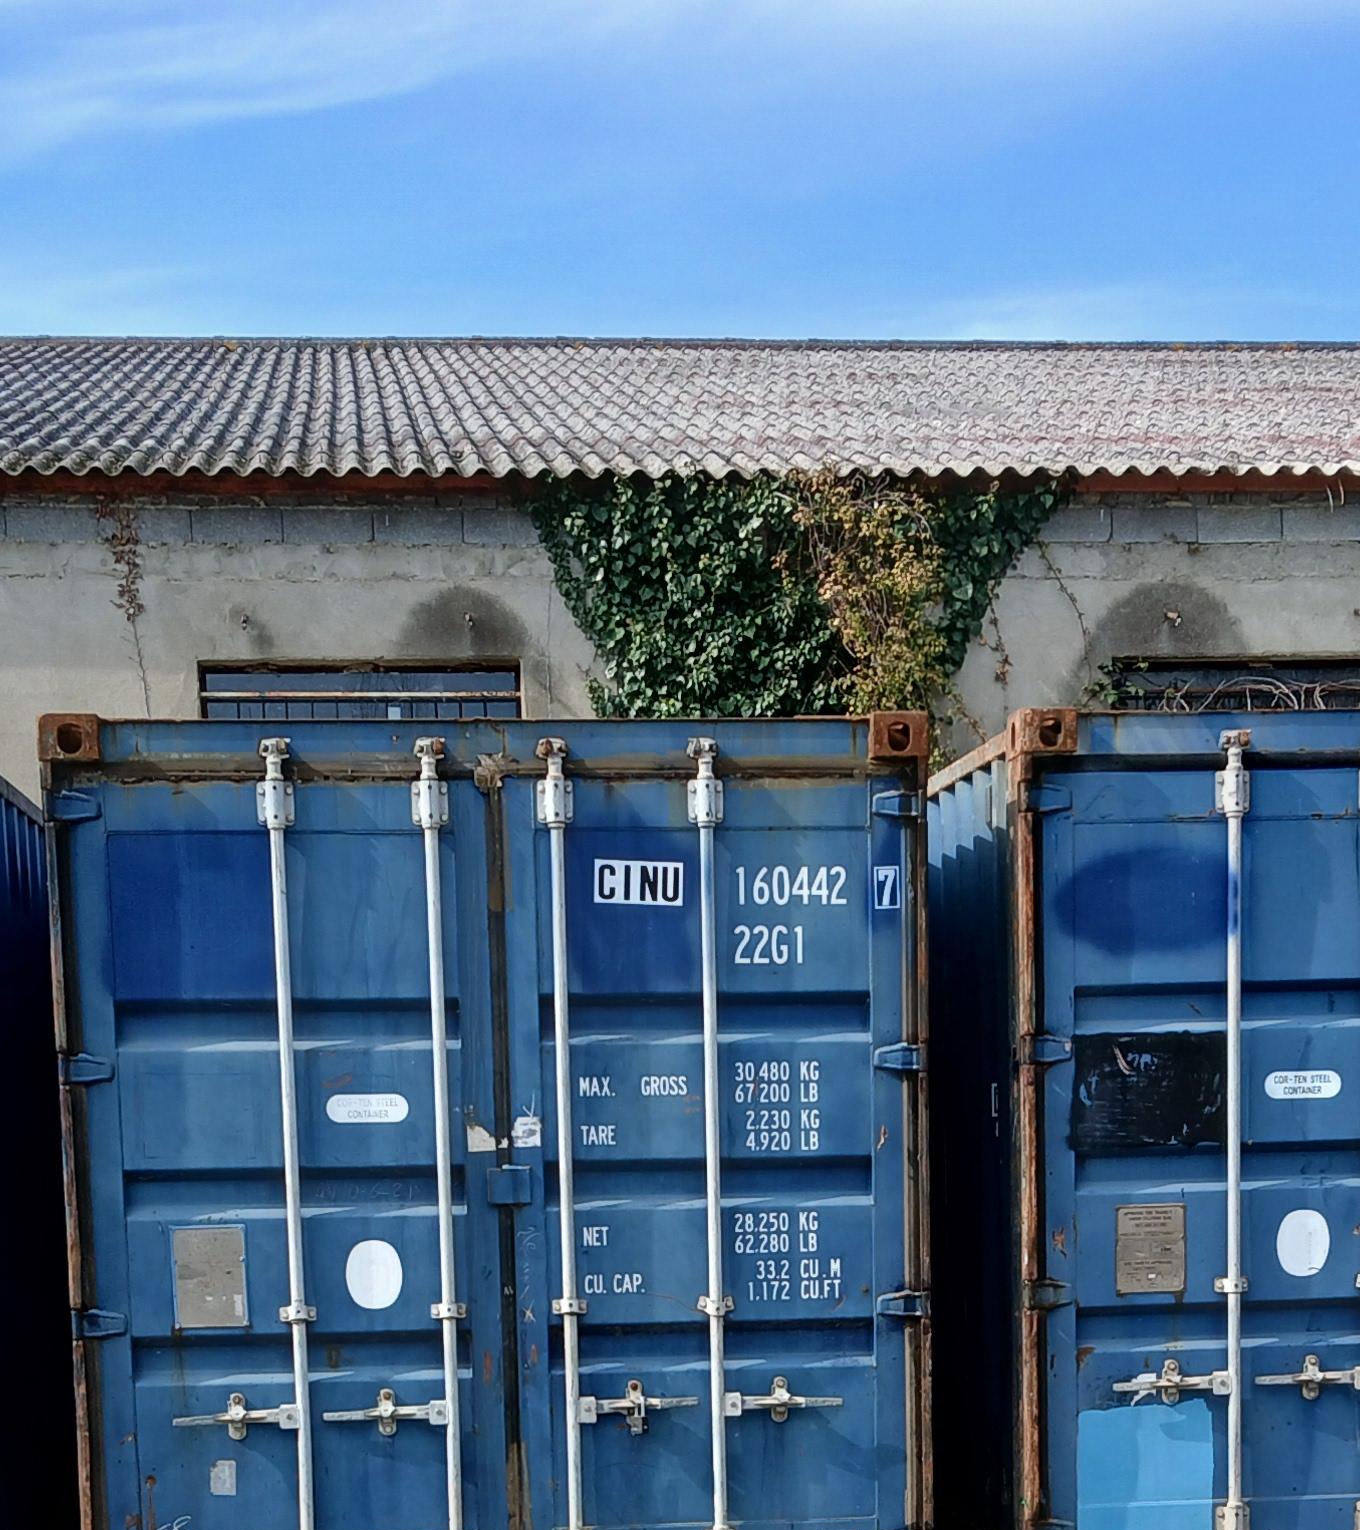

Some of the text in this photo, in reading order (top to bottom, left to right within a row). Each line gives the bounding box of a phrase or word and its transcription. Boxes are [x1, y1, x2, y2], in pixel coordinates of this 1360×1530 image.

[597, 863, 898, 908] CINU 160442 7
[733, 924, 804, 964] 22G1
[578, 1060, 820, 1097] MAX. GROSS 30.480 KG
[800, 1083, 819, 1103] LB
[580, 1109, 820, 1146] TARE 2.230 KG
[745, 1131, 819, 1151] 4.920 LB
[582, 1211, 819, 1247] NET 28.250 KG
[734, 1233, 818, 1254] 62.280 LB
[755, 1260, 790, 1280] 33.2
[747, 1279, 842, 1301] 1.172 CU.FT
